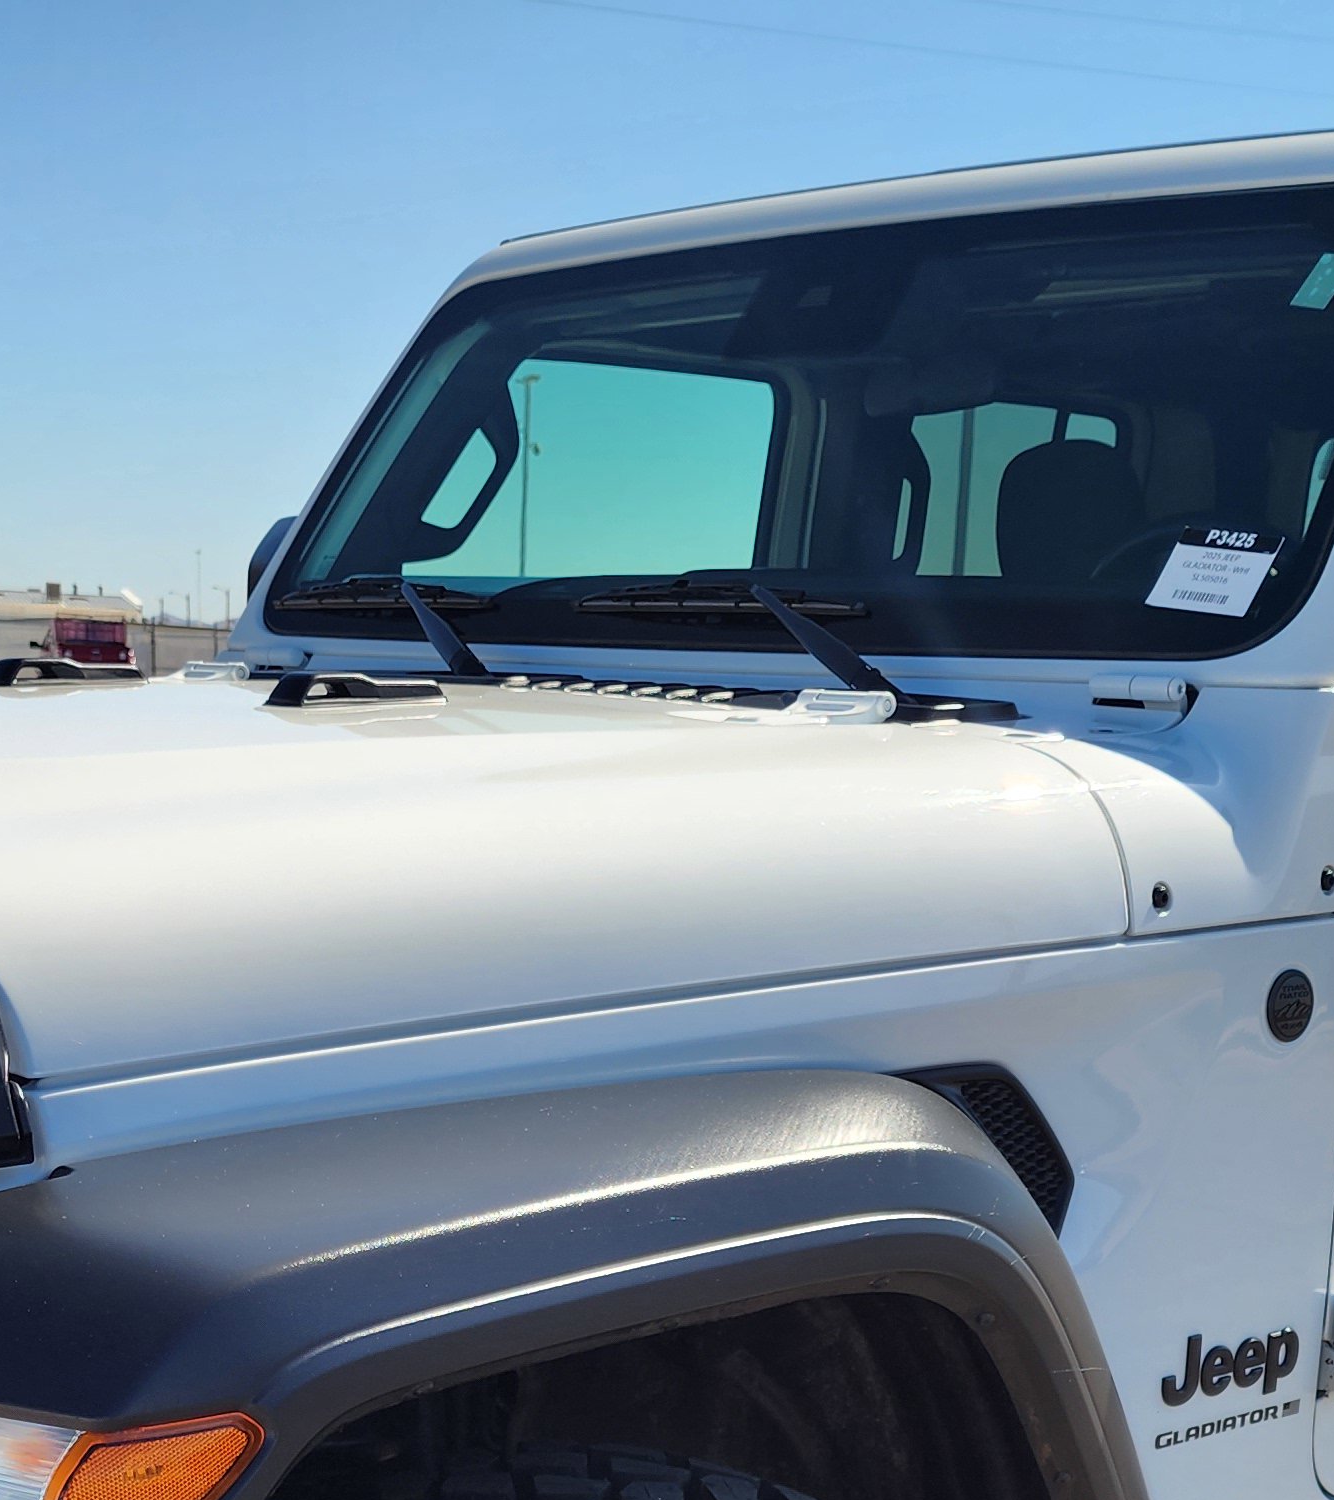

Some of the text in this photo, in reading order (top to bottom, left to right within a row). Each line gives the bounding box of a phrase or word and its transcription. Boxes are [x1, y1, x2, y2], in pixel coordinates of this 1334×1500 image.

[1205, 529, 1258, 548] P3425
[1202, 551, 1242, 561] 2025 JEEP
[1182, 559, 1228, 573] GLADIATOR
[1161, 1326, 1299, 1407] Jeep
[1154, 1405, 1279, 1450] GLADIATOR
